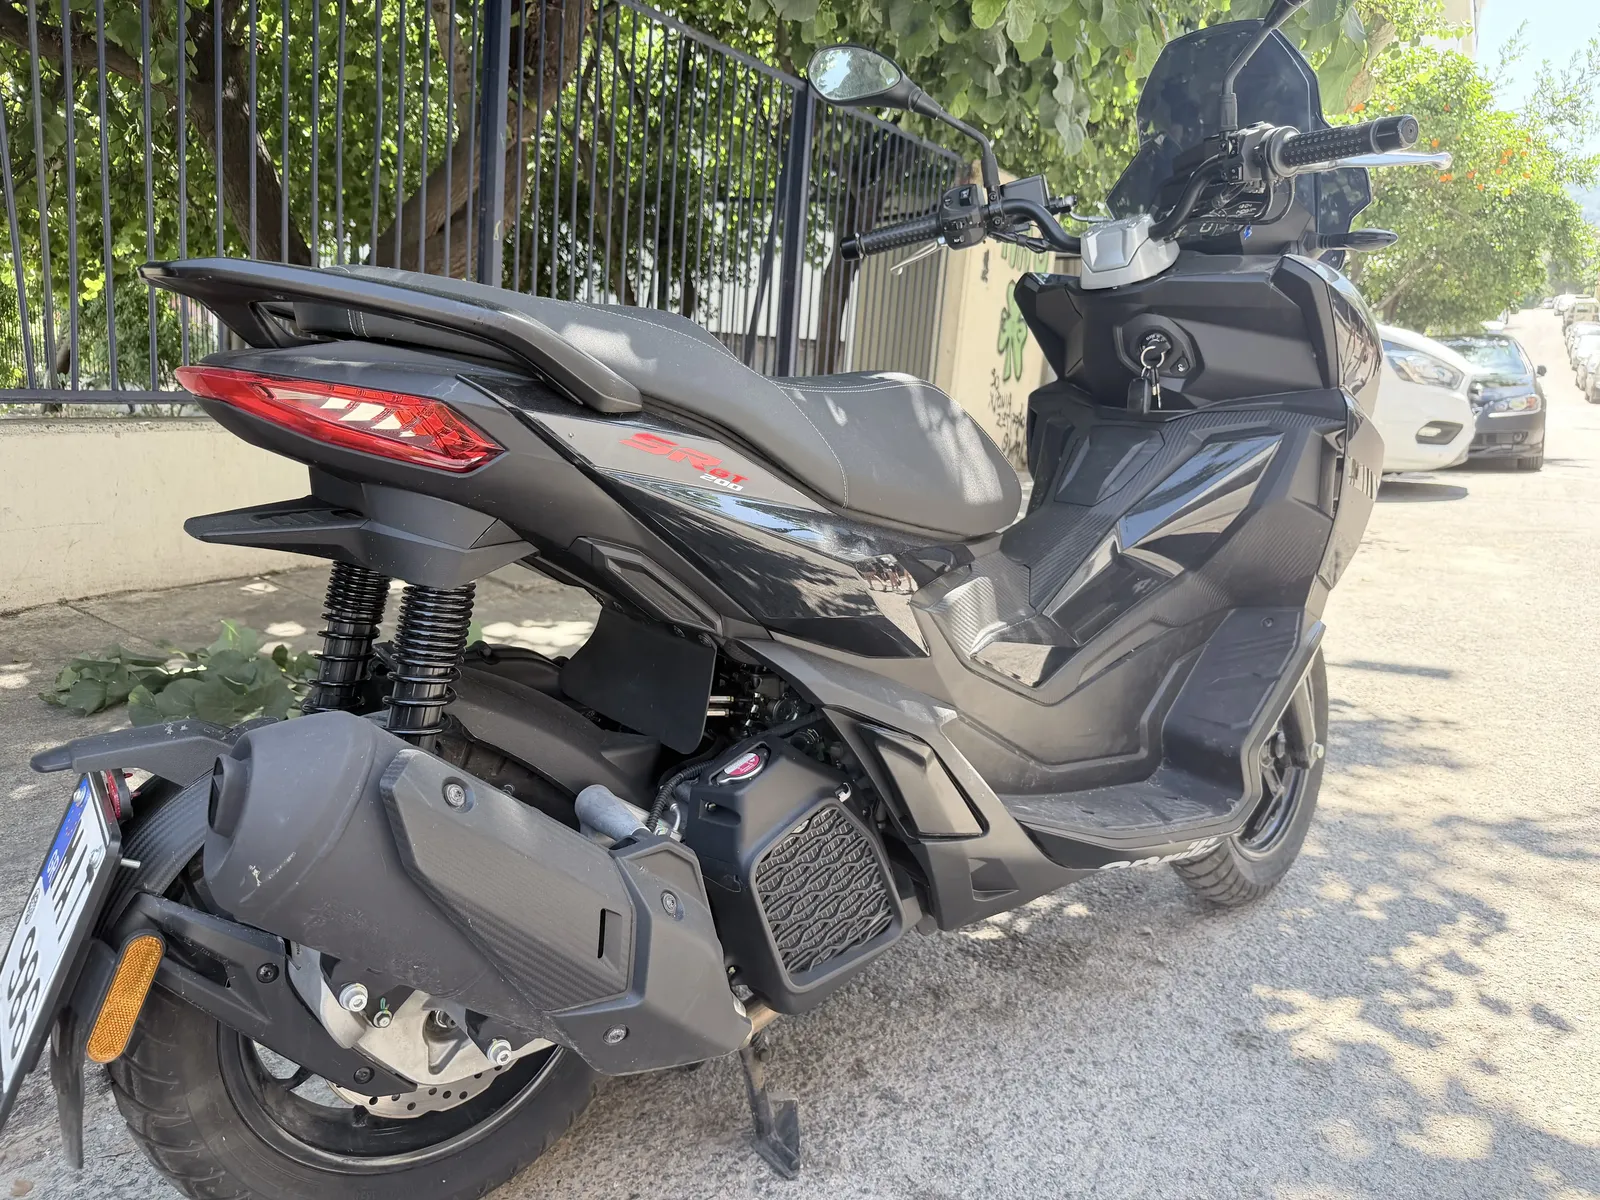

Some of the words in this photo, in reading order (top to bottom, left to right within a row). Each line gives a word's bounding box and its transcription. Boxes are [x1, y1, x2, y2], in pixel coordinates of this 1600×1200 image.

[619, 432, 723, 472] SR
[709, 467, 749, 484] GT
[700, 472, 744, 492] 200
[47, 849, 60, 883] GR
[7, 926, 41, 1060] 986
